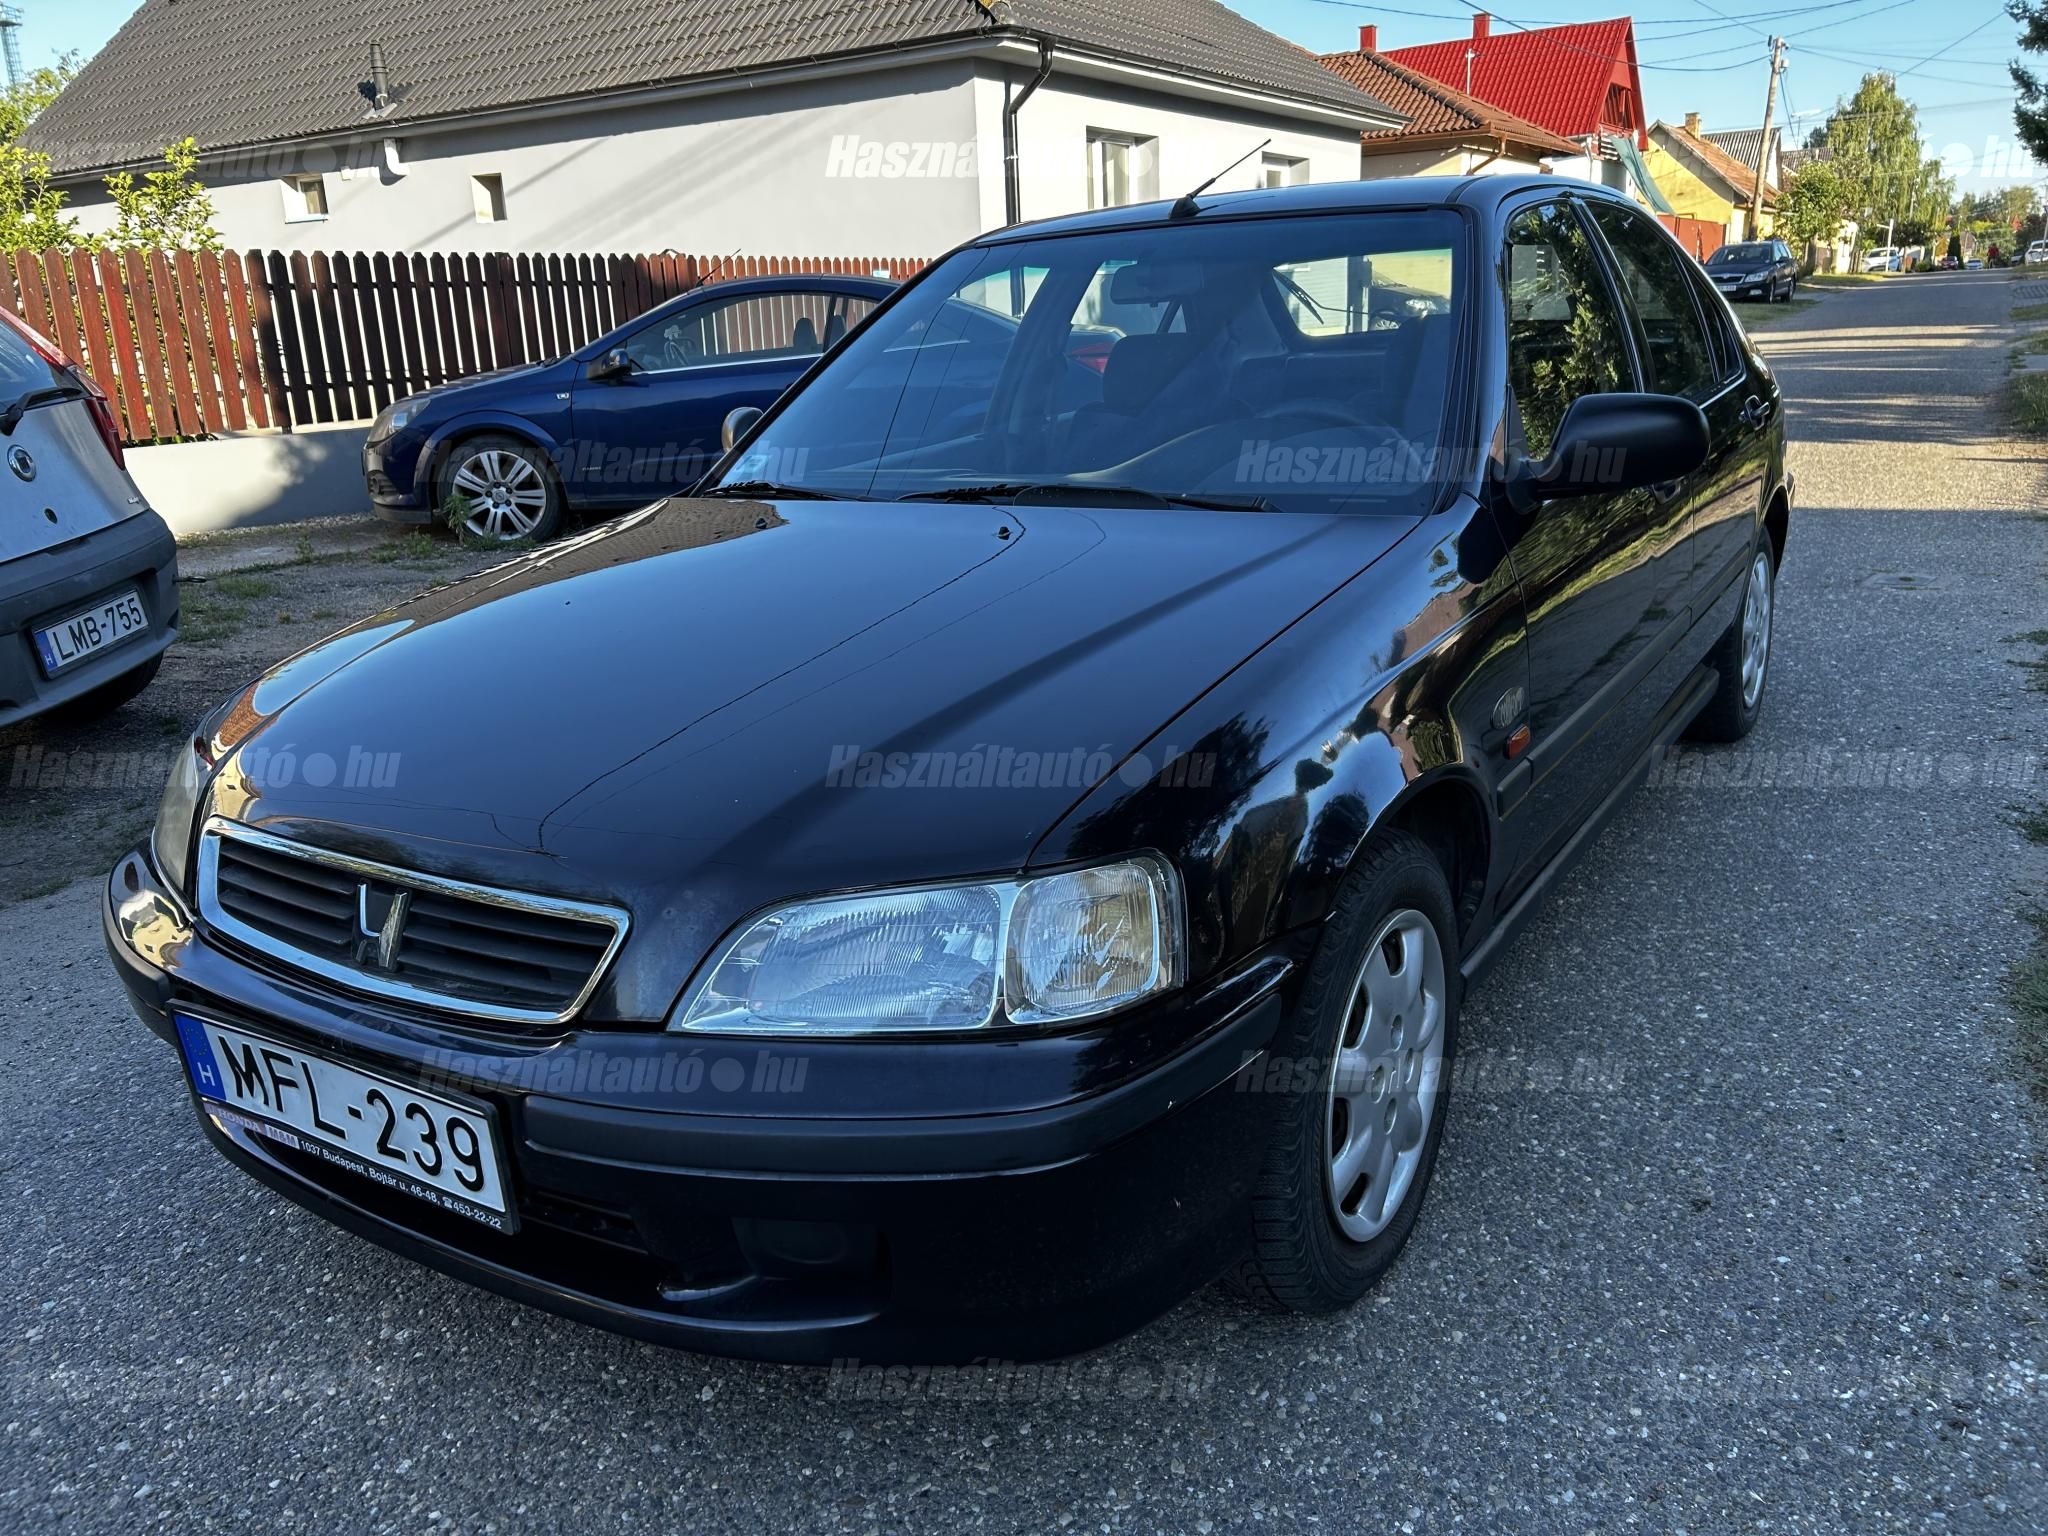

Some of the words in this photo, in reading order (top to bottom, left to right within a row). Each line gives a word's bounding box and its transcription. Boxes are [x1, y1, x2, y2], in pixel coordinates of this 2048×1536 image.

[53, 598, 142, 660] LMB-755
[197, 1062, 216, 1087] H
[218, 1034, 486, 1193] MFL-239
[219, 1111, 261, 1132] HONDA
[300, 1140, 321, 1156] 1037
[322, 1148, 368, 1178] Budapest,
[368, 1167, 397, 1186] Bojtár
[399, 1181, 409, 1192] u.
